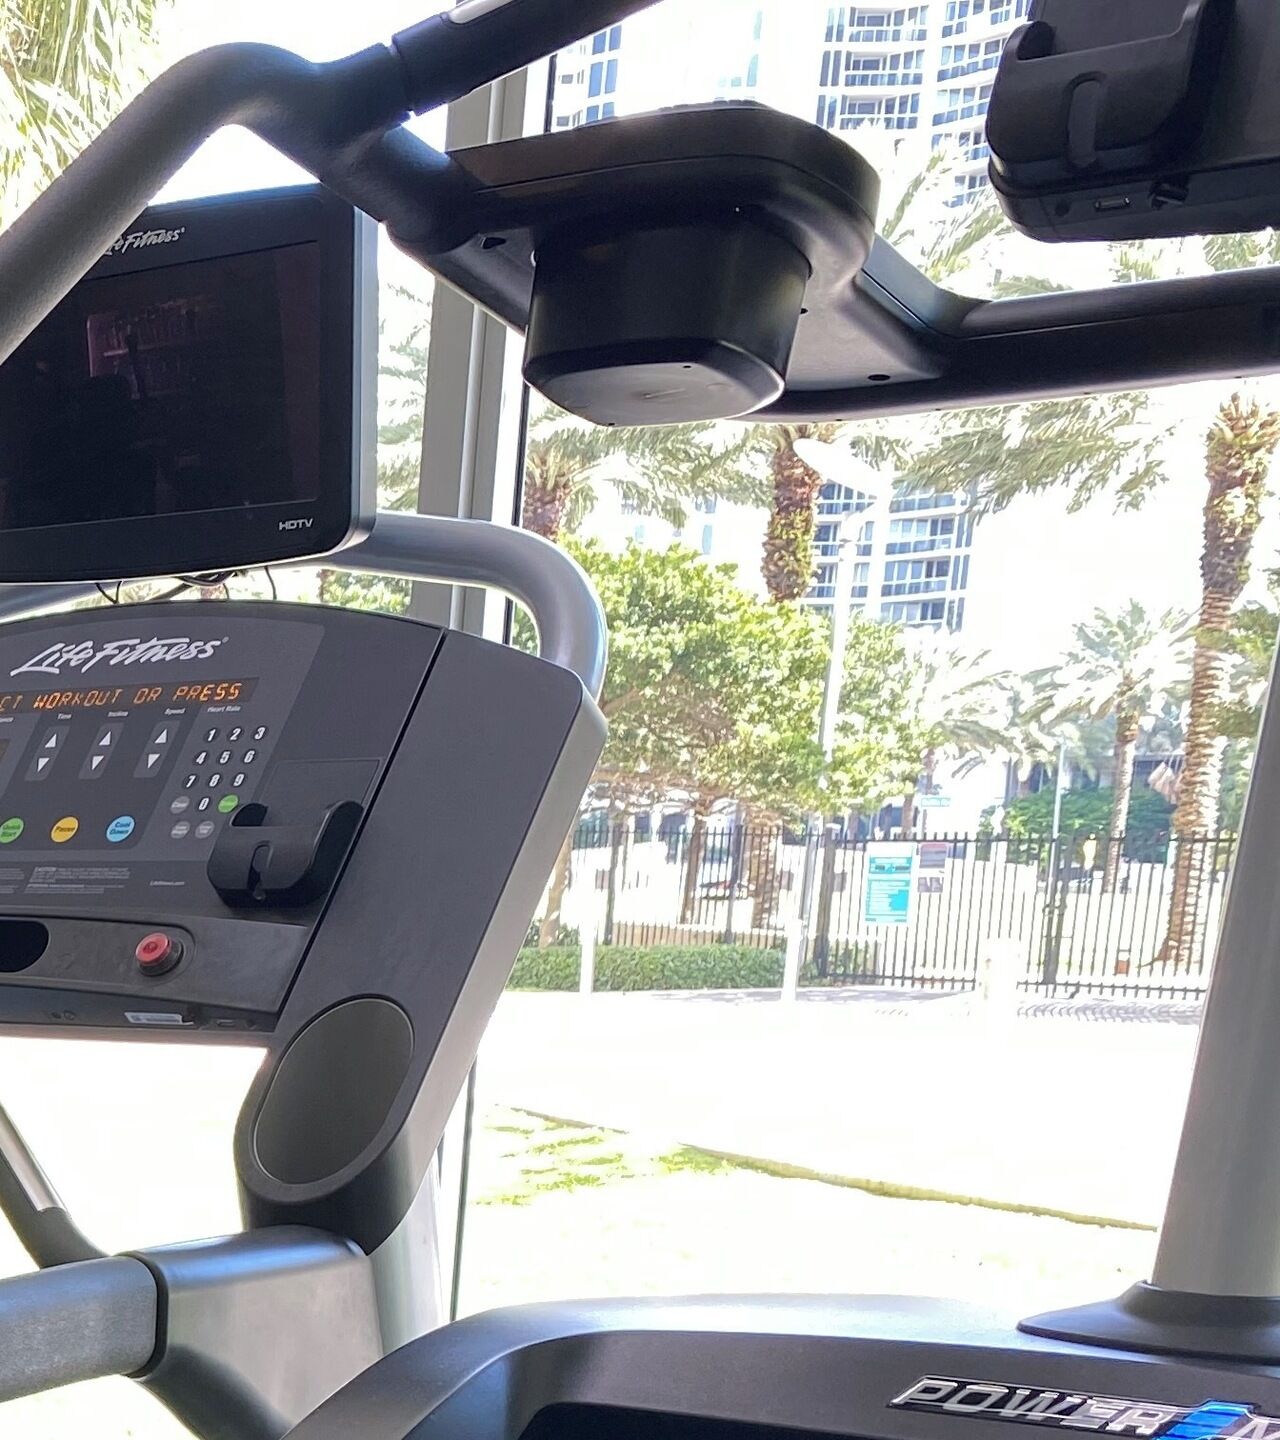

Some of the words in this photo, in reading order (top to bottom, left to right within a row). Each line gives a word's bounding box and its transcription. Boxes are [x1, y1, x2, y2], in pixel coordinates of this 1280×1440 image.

[278, 518, 313, 531] HDTV
[33, 687, 123, 709] WORKOUT
[133, 686, 162, 705] OR
[173, 682, 242, 702] PRESS
[207, 729, 217, 741] 1
[229, 728, 241, 741] 2
[254, 727, 266, 740] 3
[196, 752, 207, 764] 4
[219, 751, 231, 764] 5
[243, 750, 255, 763] 6
[186, 775, 197, 788] 7
[209, 774, 220, 787] 8
[233, 773, 245, 786] 9
[891, 1377, 1176, 1437] POWER
